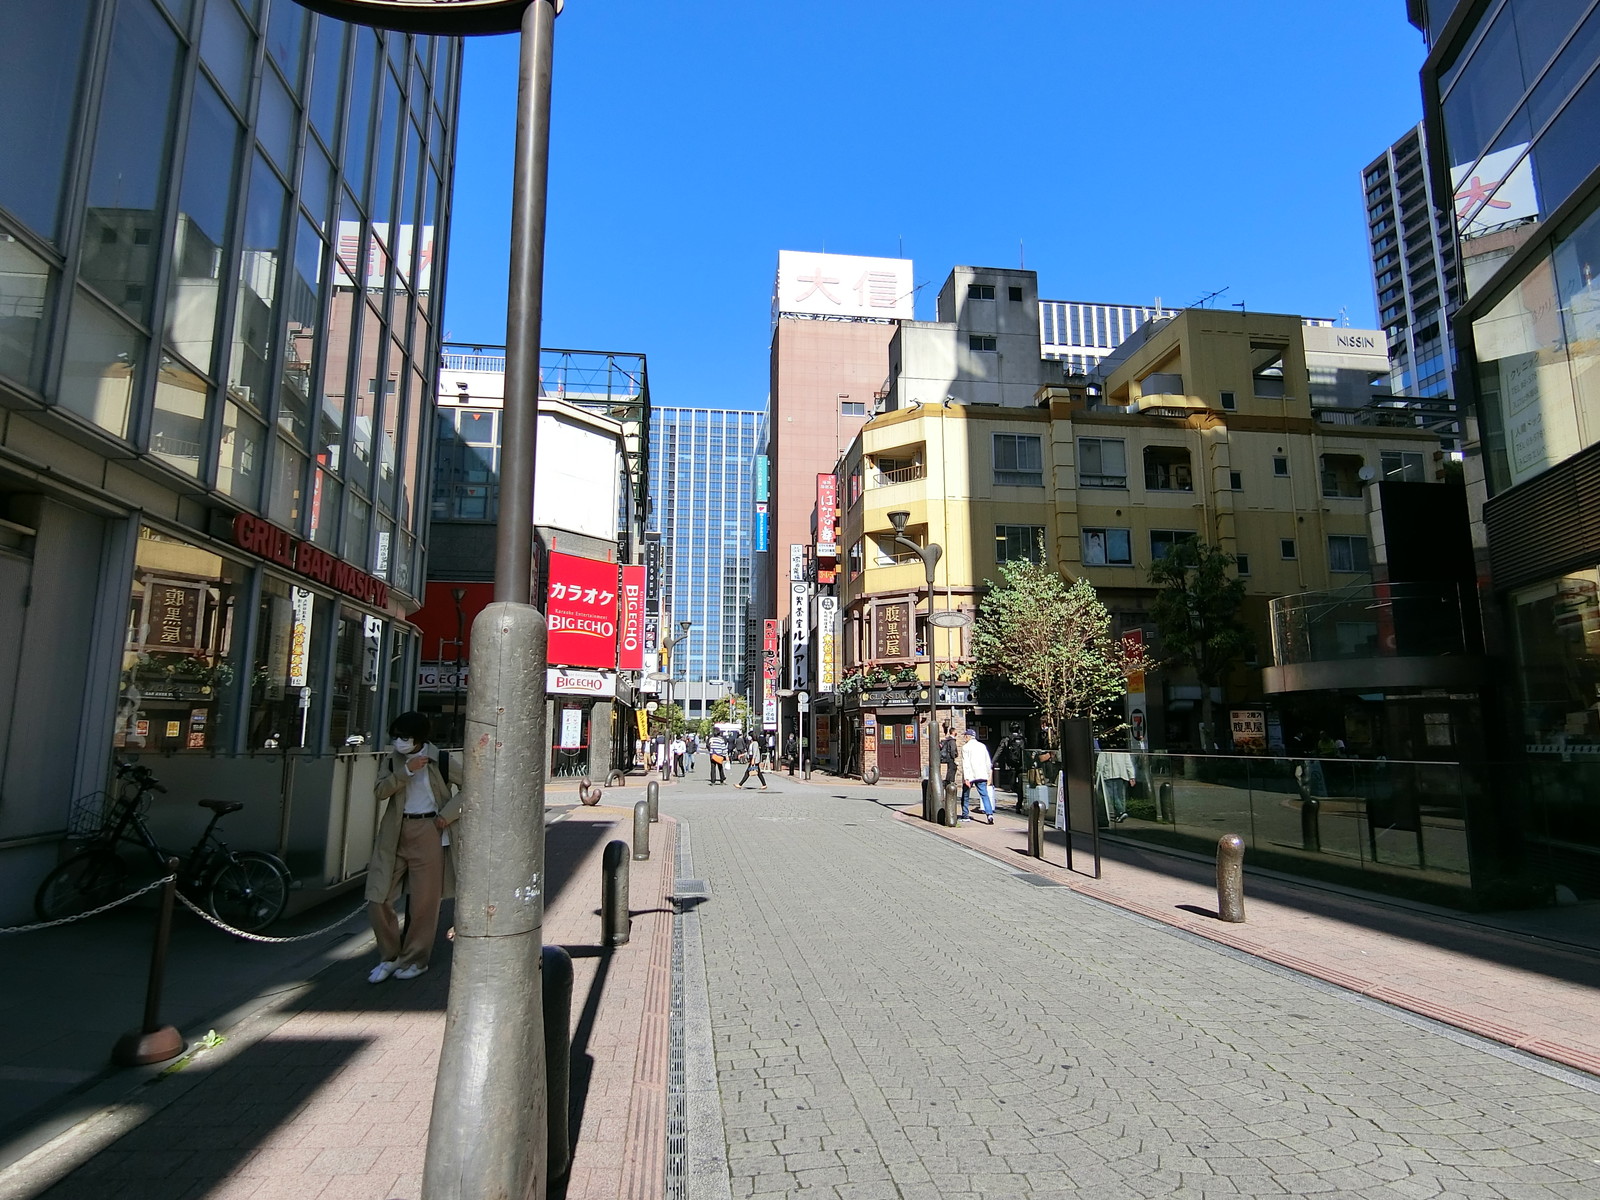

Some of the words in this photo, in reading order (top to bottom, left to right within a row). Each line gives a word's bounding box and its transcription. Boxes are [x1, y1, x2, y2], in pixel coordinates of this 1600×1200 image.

[796, 267, 898, 308] 大信
[1337, 335, 1374, 348] NISSIN
[233, 512, 293, 569] GRILL
[298, 541, 334, 584] BAR
[550, 582, 614, 605] カラオケ
[626, 585, 638, 613] BIG
[549, 614, 575, 630] BIG
[578, 619, 614, 636] ECHO
[555, 608, 574, 616] Karaoke
[575, 611, 608, 620] Entertainment
[624, 614, 638, 651] ECHO
[885, 605, 900, 656] 腹黒屋
[419, 674, 435, 685] IG
[440, 673, 468, 687] ECH
[556, 677, 575, 688] BIG
[576, 678, 602, 690] ECHO
[870, 691, 895, 700] GLASS
[1233, 721, 1263, 733] 腹黒屋
